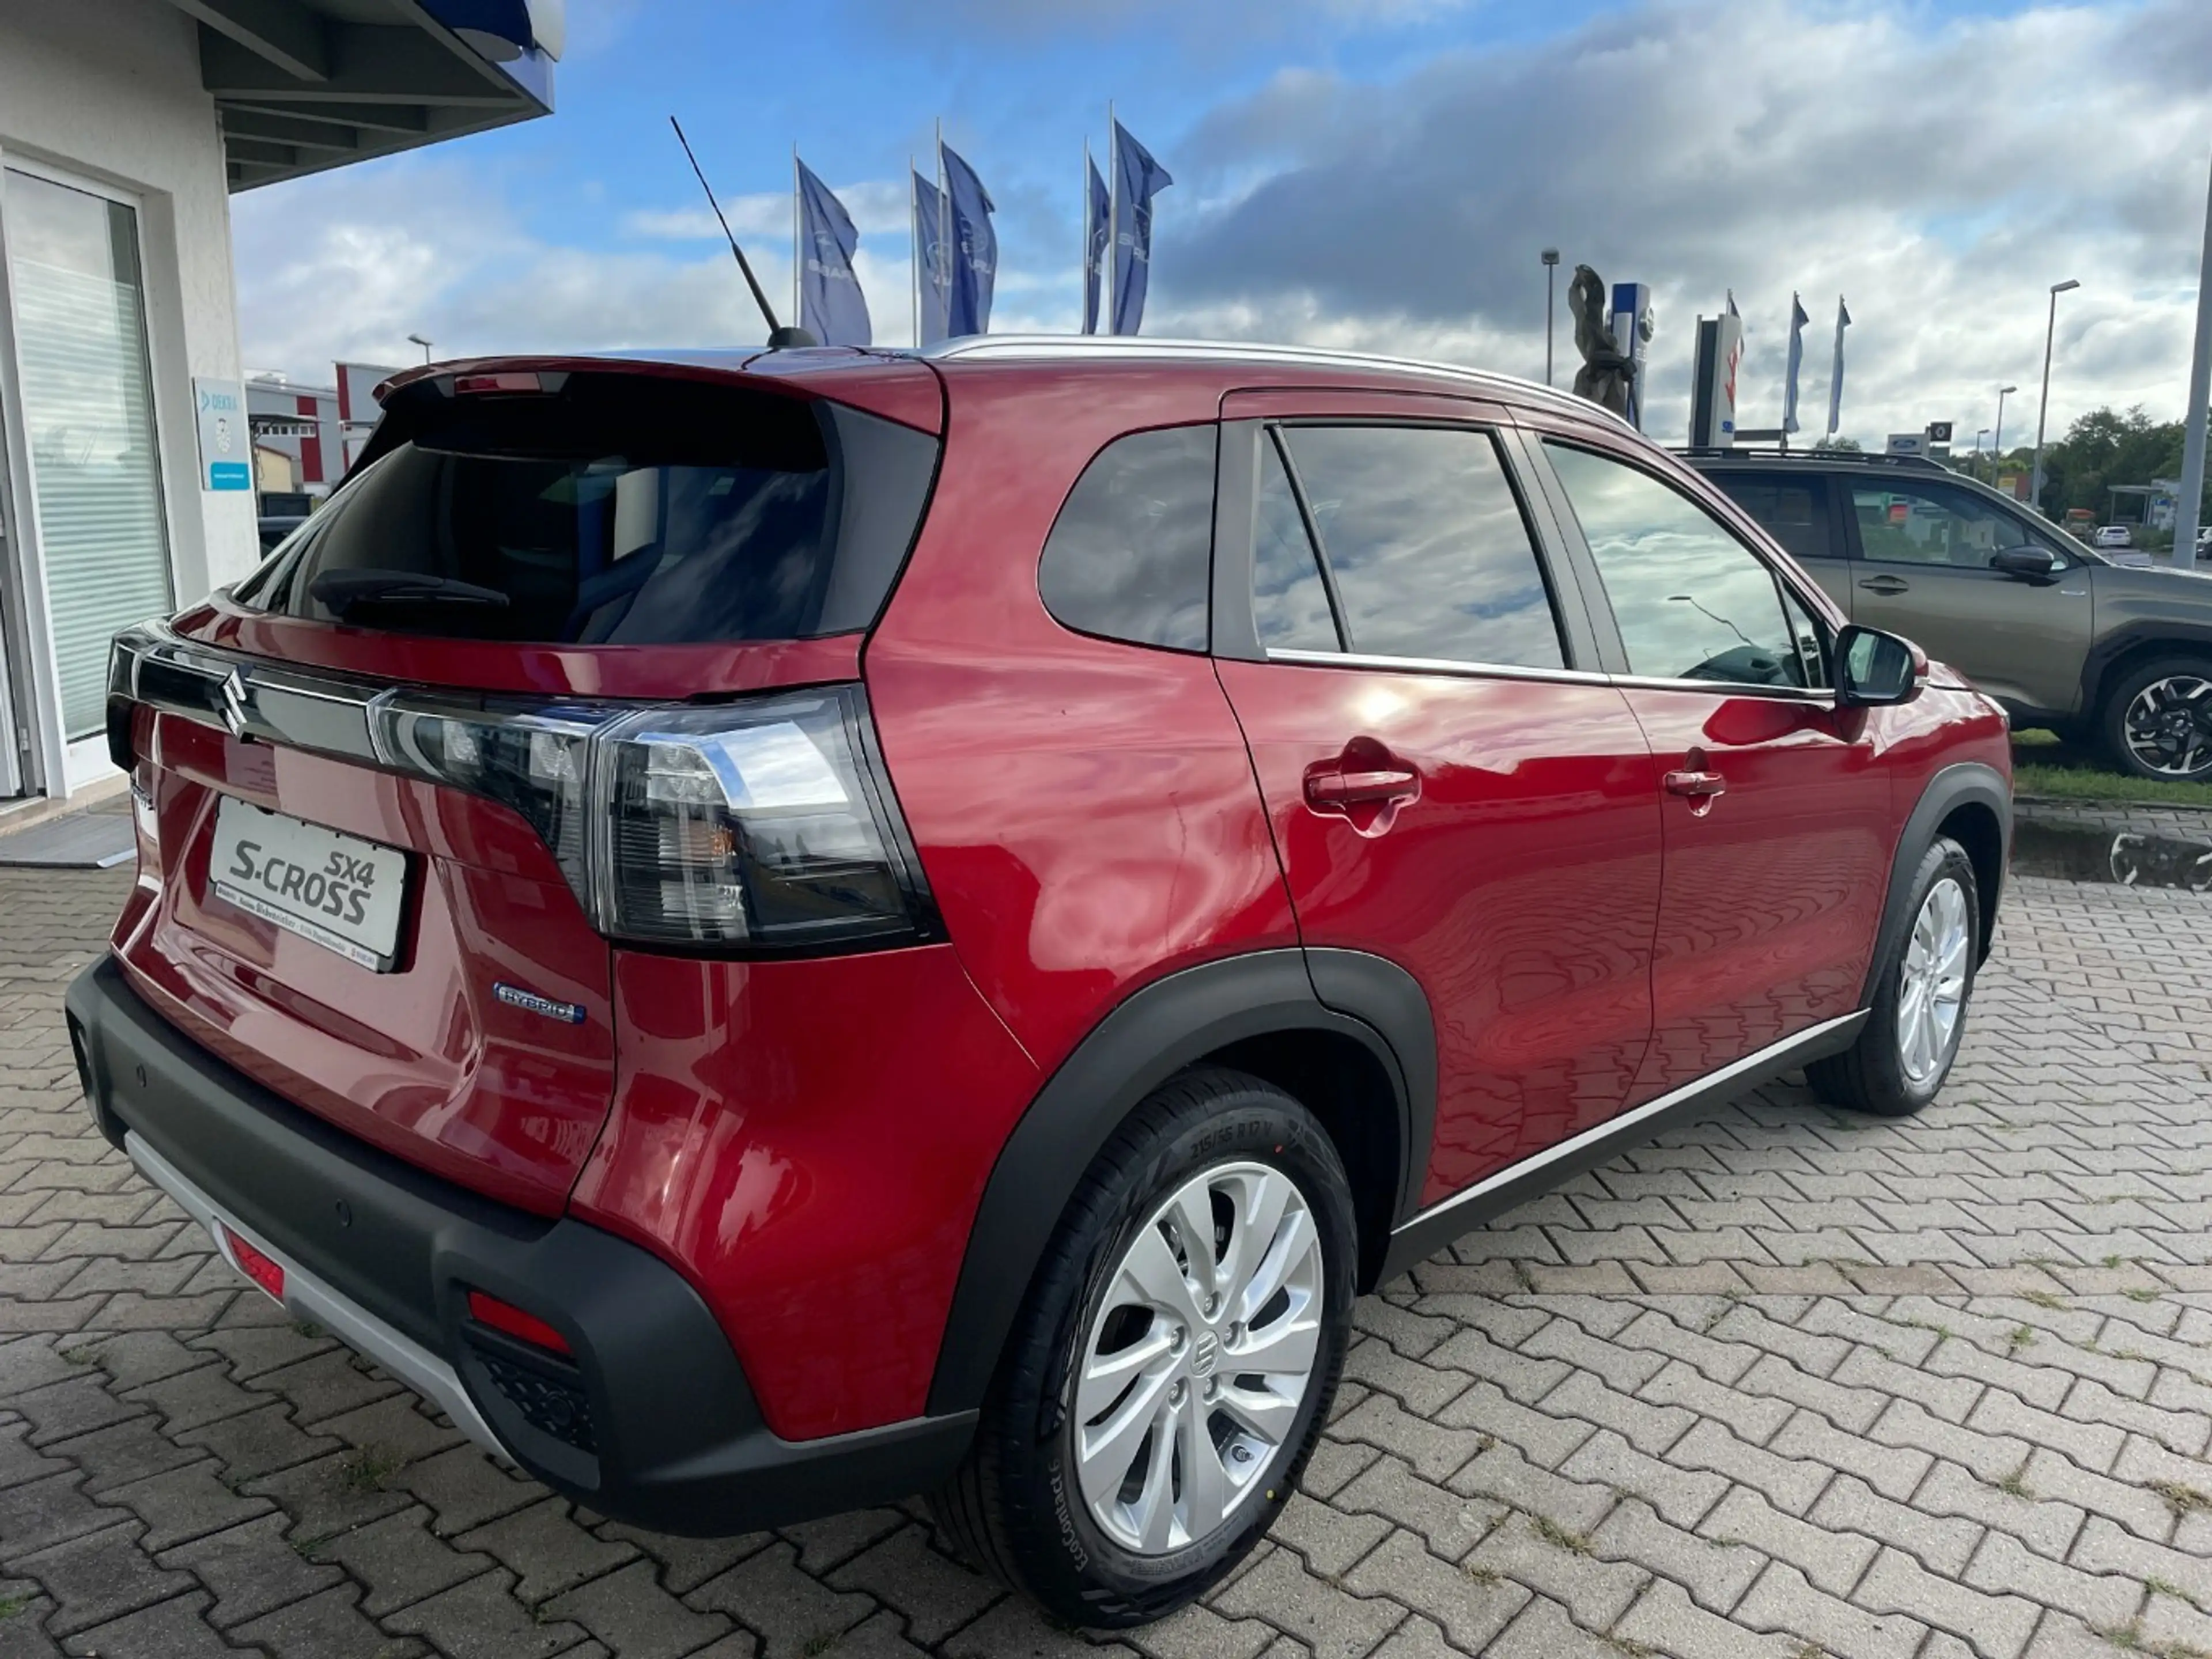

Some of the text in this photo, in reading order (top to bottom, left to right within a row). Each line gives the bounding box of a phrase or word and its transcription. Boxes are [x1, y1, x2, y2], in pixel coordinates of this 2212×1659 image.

[324, 851, 375, 888] SX4
[504, 990, 568, 1016] HYBRID
[1190, 1126, 1232, 1160] 215/55
[1050, 1472, 1089, 1573] EcoContact
